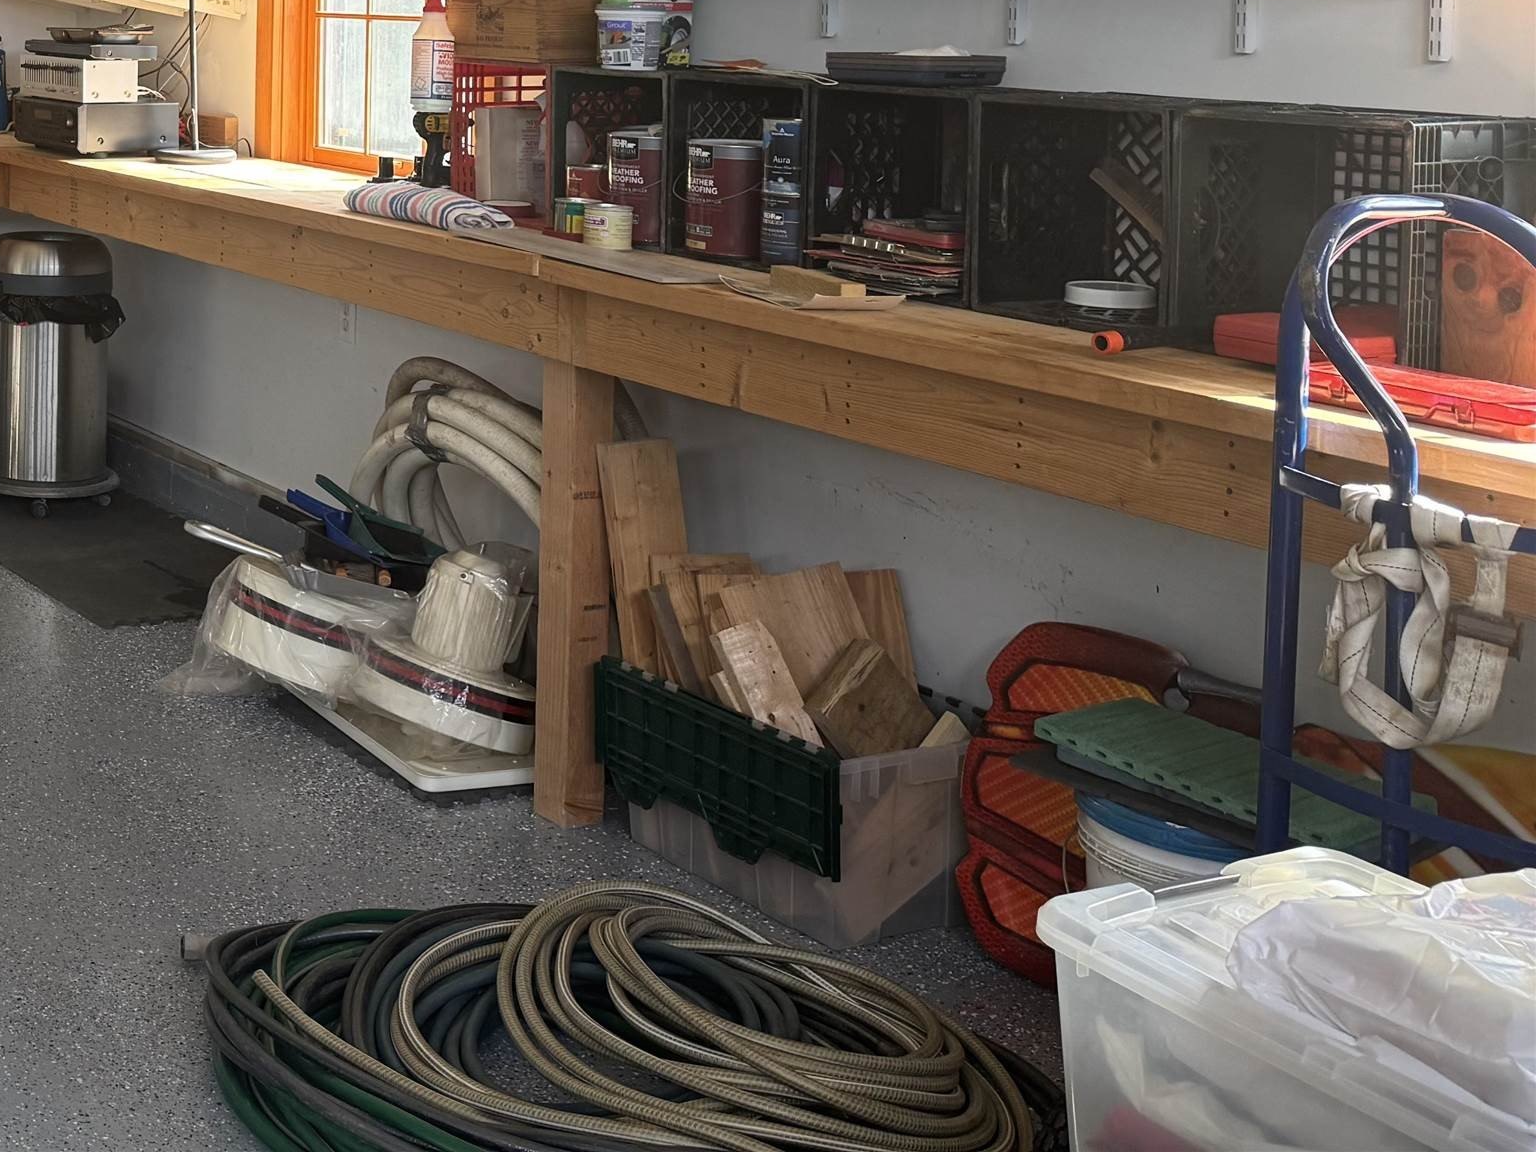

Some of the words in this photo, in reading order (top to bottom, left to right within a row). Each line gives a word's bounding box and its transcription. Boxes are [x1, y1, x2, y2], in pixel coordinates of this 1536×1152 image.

[773, 155, 791, 164] Aura
[613, 167, 640, 177] EATHER
[613, 175, 644, 185] OOFING
[690, 185, 718, 195] OOFING
